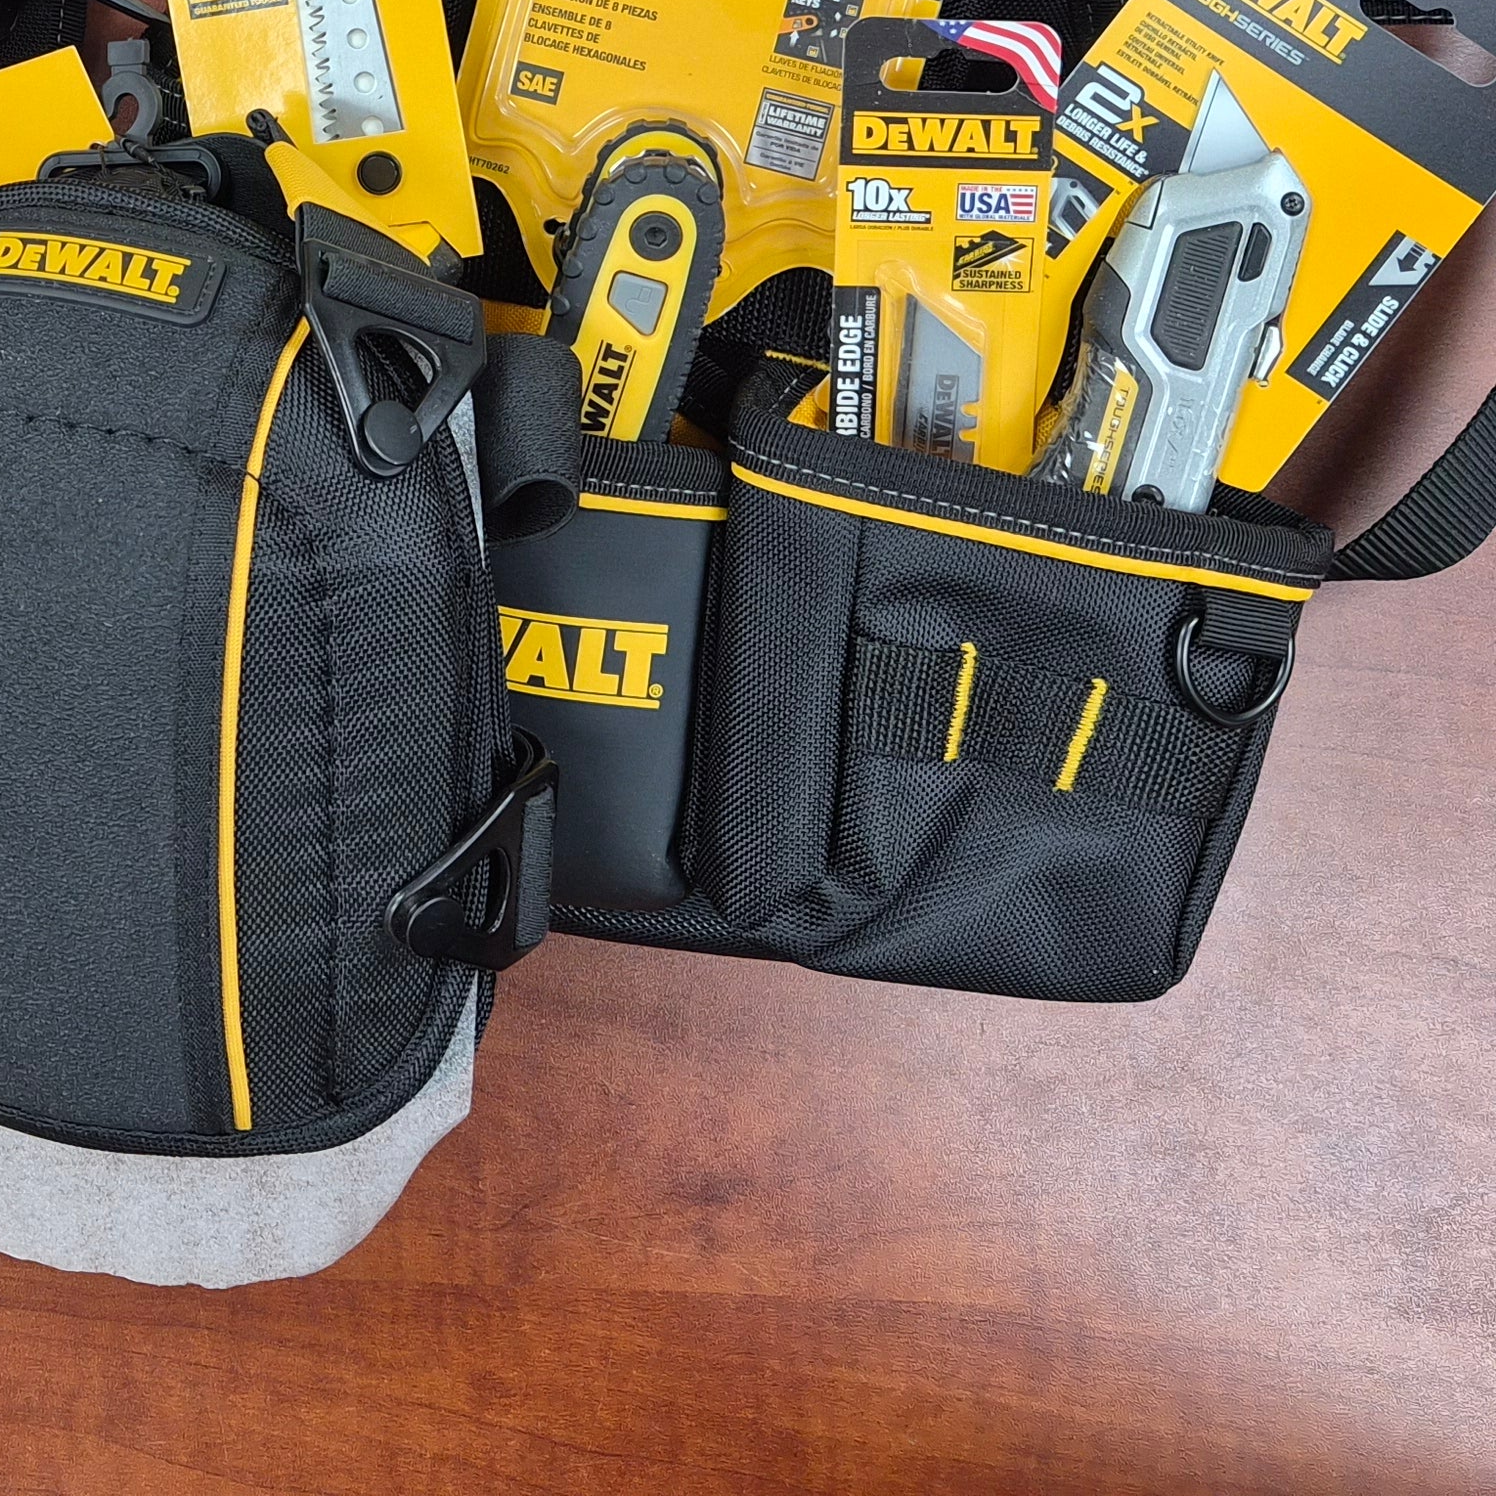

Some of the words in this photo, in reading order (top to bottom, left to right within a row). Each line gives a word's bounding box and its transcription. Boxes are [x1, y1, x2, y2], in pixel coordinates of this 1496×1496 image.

[531, 3, 586, 23] ENSEMBLE
[589, 16, 603, 27] DE
[604, 20, 612, 30] 8
[612, 1, 619, 11] 8
[621, 3, 658, 21] PIEZAS
[528, 18, 584, 39] CLAVETTES
[587, 31, 601, 43] DE
[524, 33, 571, 52] BLOCAGE
[572, 45, 647, 71] HEXAGONALES
[517, 71, 558, 97] SAE
[767, 116, 823, 137] WARRANTY
[769, 105, 826, 127] LIFETIME
[853, 117, 1040, 154] DEWALT
[1056, 116, 1092, 144] DEBRIS
[1064, 103, 1108, 140] LONGER
[1109, 133, 1138, 157] LIFE
[1135, 150, 1148, 164] &
[469, 156, 510, 174] HT70262
[960, 193, 1011, 214] USA
[959, 280, 1023, 289] SHARPNESS
[962, 269, 1021, 279] SUSTAINED
[865, 295, 877, 338] CARBURE
[1360, 296, 1400, 337] SLIDE
[838, 315, 863, 373] EDGE
[864, 341, 875, 353] EN
[1351, 333, 1369, 348] &
[862, 356, 874, 382] BORD
[1321, 346, 1359, 388] CLICK
[582, 342, 630, 432] WALT
[836, 378, 860, 435] BIDE
[860, 393, 872, 439] CARBONO
[500, 618, 668, 698] ALT
